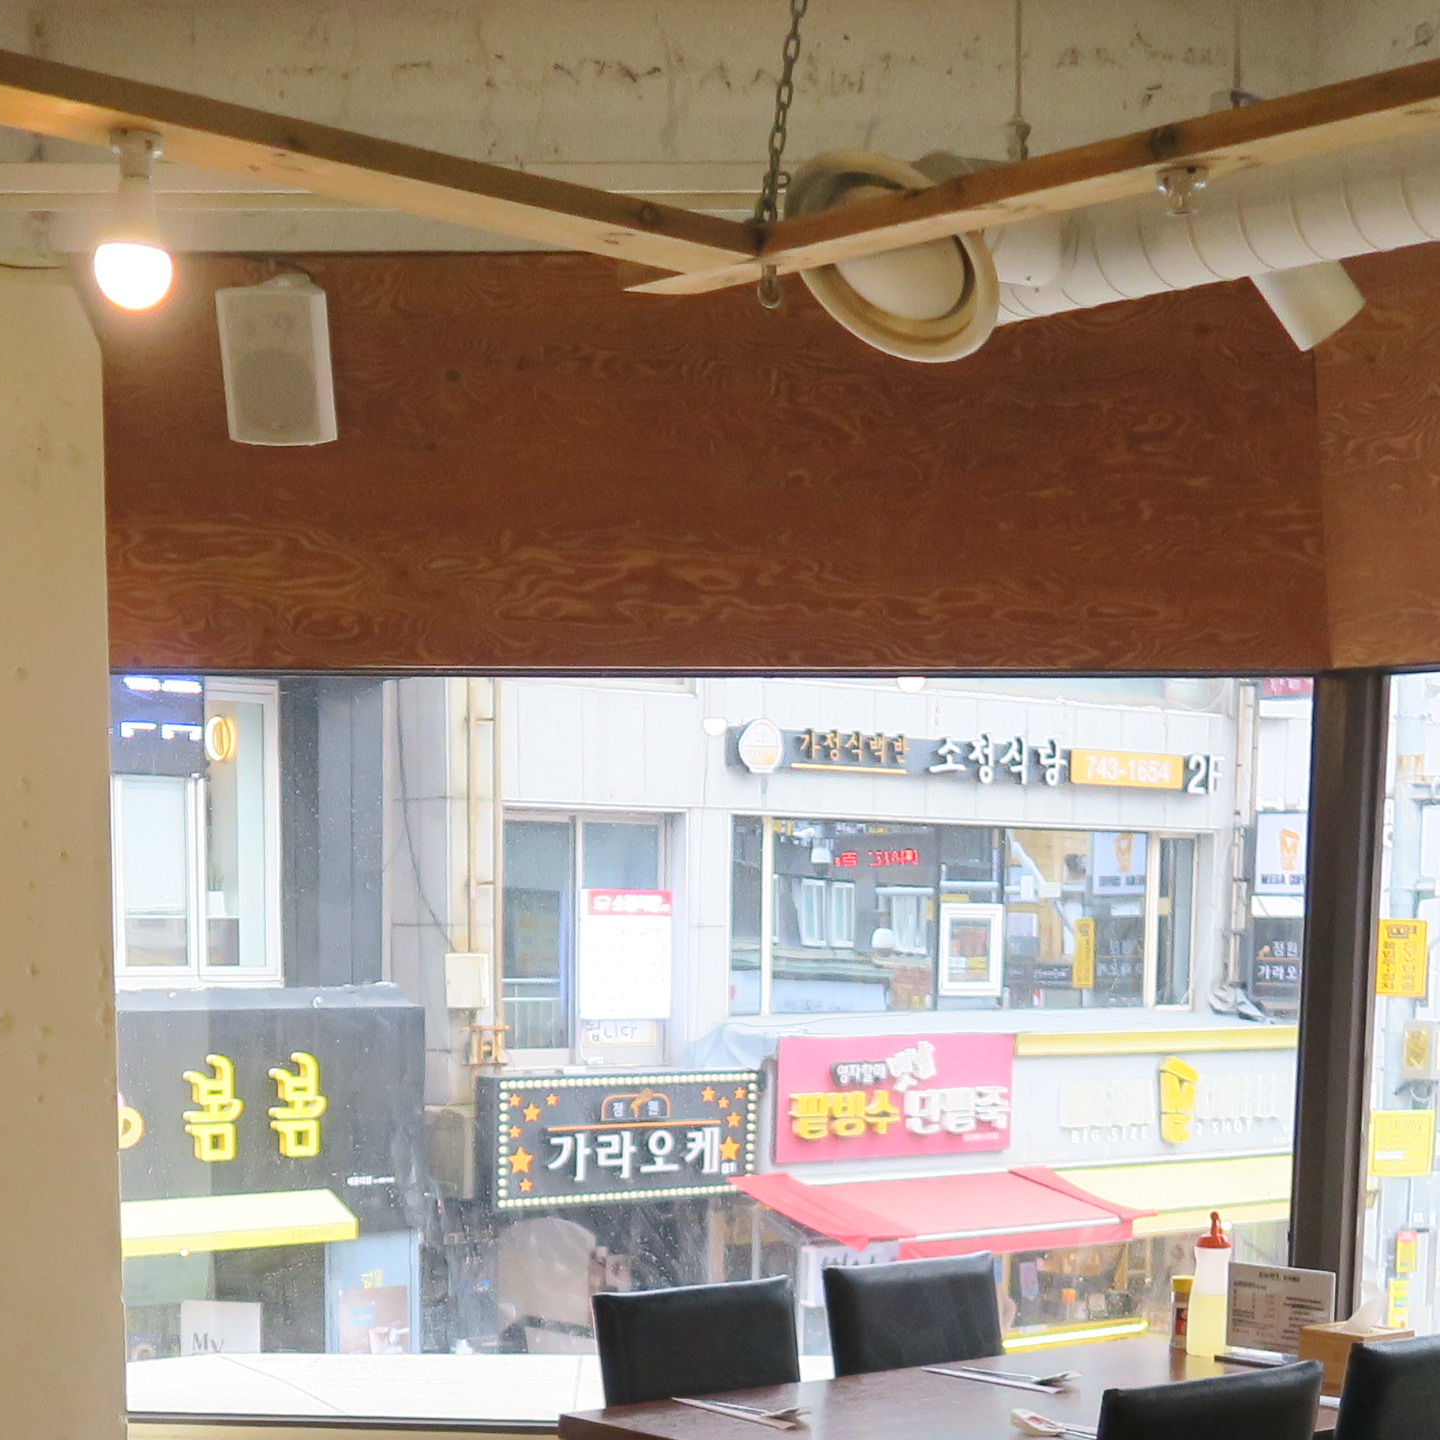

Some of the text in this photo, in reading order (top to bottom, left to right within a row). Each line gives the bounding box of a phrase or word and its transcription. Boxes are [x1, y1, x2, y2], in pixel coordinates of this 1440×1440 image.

[928, 733, 1069, 787] 소정식당
[1084, 755, 1171, 785] 743-1654
[1258, 963, 1301, 981] 가라오
[788, 1089, 901, 1141] 팥빙수
[903, 1085, 1012, 1137] 단팥죽
[1211, 1118, 1254, 1135] SHOT
[1070, 1125, 1150, 1144] BIG SIZE
[547, 1126, 722, 1182] 가라오케
